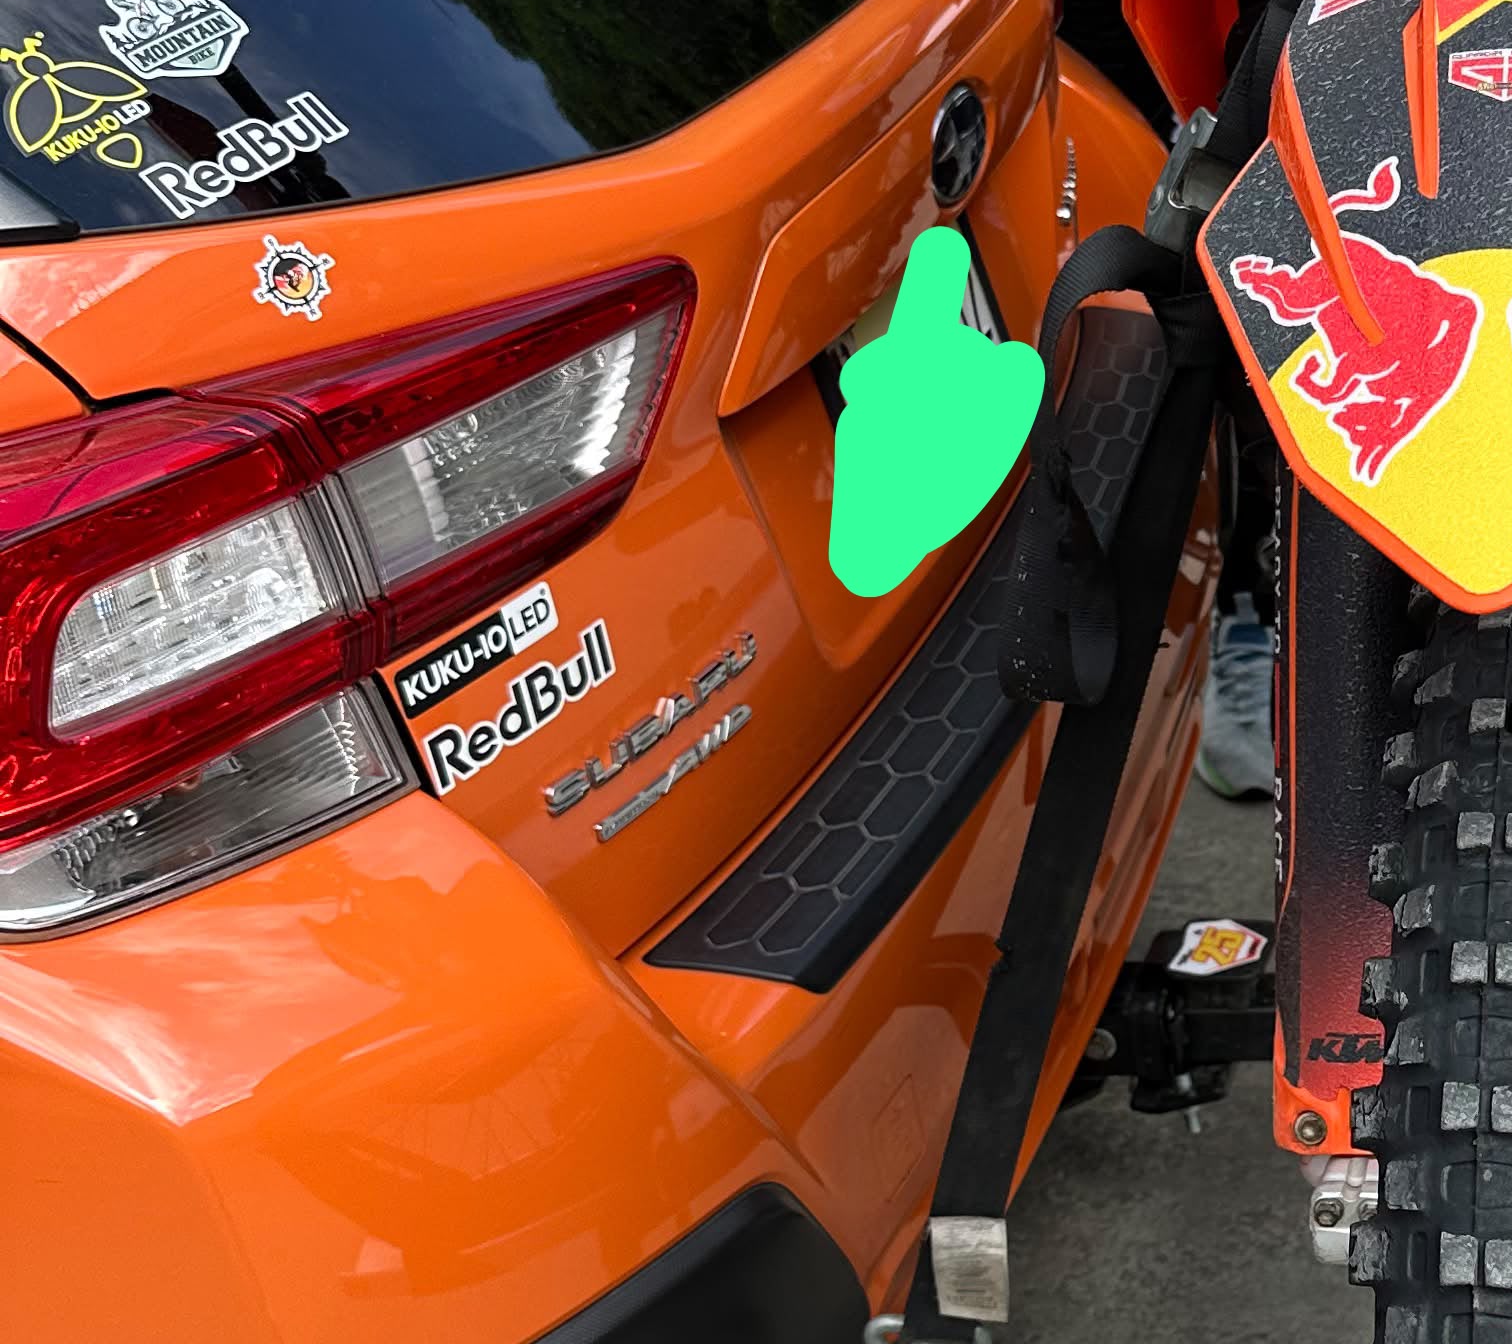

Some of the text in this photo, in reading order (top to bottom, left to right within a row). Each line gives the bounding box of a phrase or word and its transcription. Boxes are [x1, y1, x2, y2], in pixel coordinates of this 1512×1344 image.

[133, 14, 232, 68] MOUNTAIN
[116, 98, 151, 125] LED
[141, 93, 346, 216] RedBull
[508, 597, 550, 641] LED
[426, 621, 614, 792] RedBull
[541, 632, 757, 817] SUBARU
[1190, 923, 1248, 967] 25
